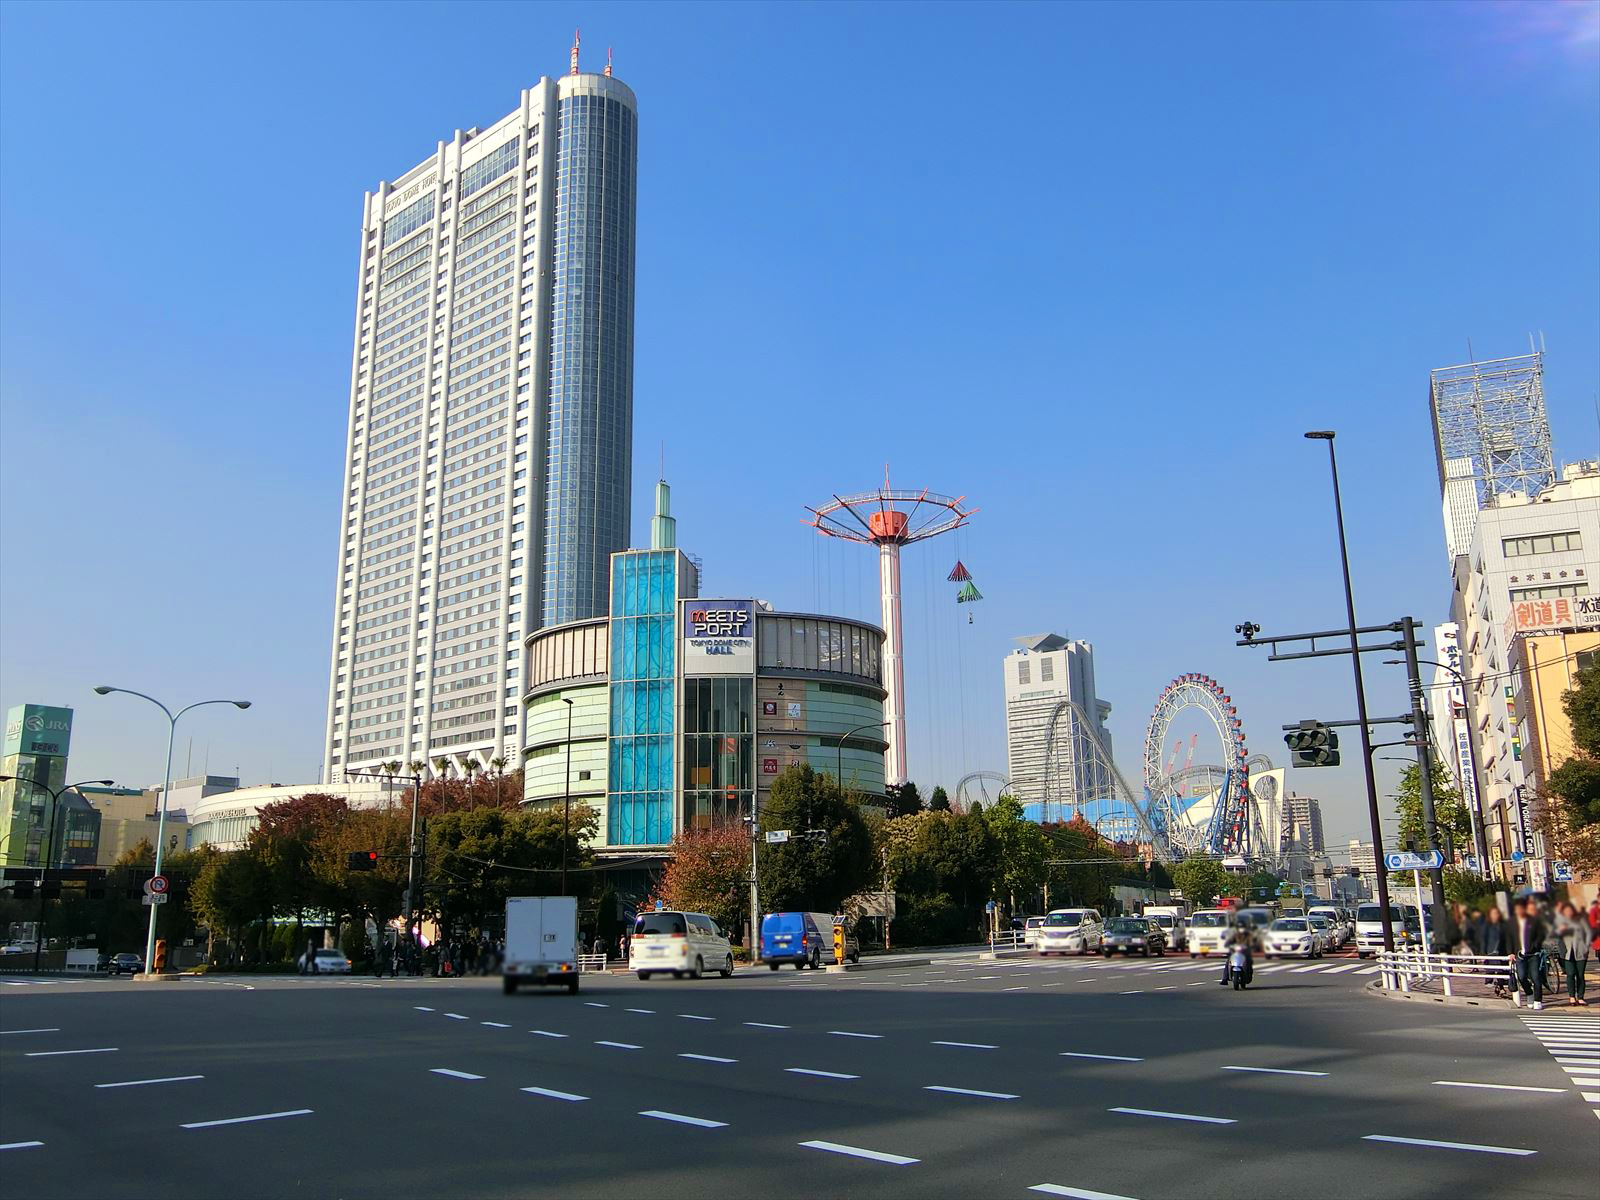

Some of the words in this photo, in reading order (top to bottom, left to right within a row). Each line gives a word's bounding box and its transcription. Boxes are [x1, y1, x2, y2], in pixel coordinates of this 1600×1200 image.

[690, 610, 748, 622] MEETS
[1516, 599, 1572, 628] 剣道具
[694, 623, 744, 635] PORT
[706, 646, 735, 655] HALL
[1446, 645, 1460, 667] ホテル
[46, 720, 70, 731] JRA
[1519, 788, 1528, 805] NEW
